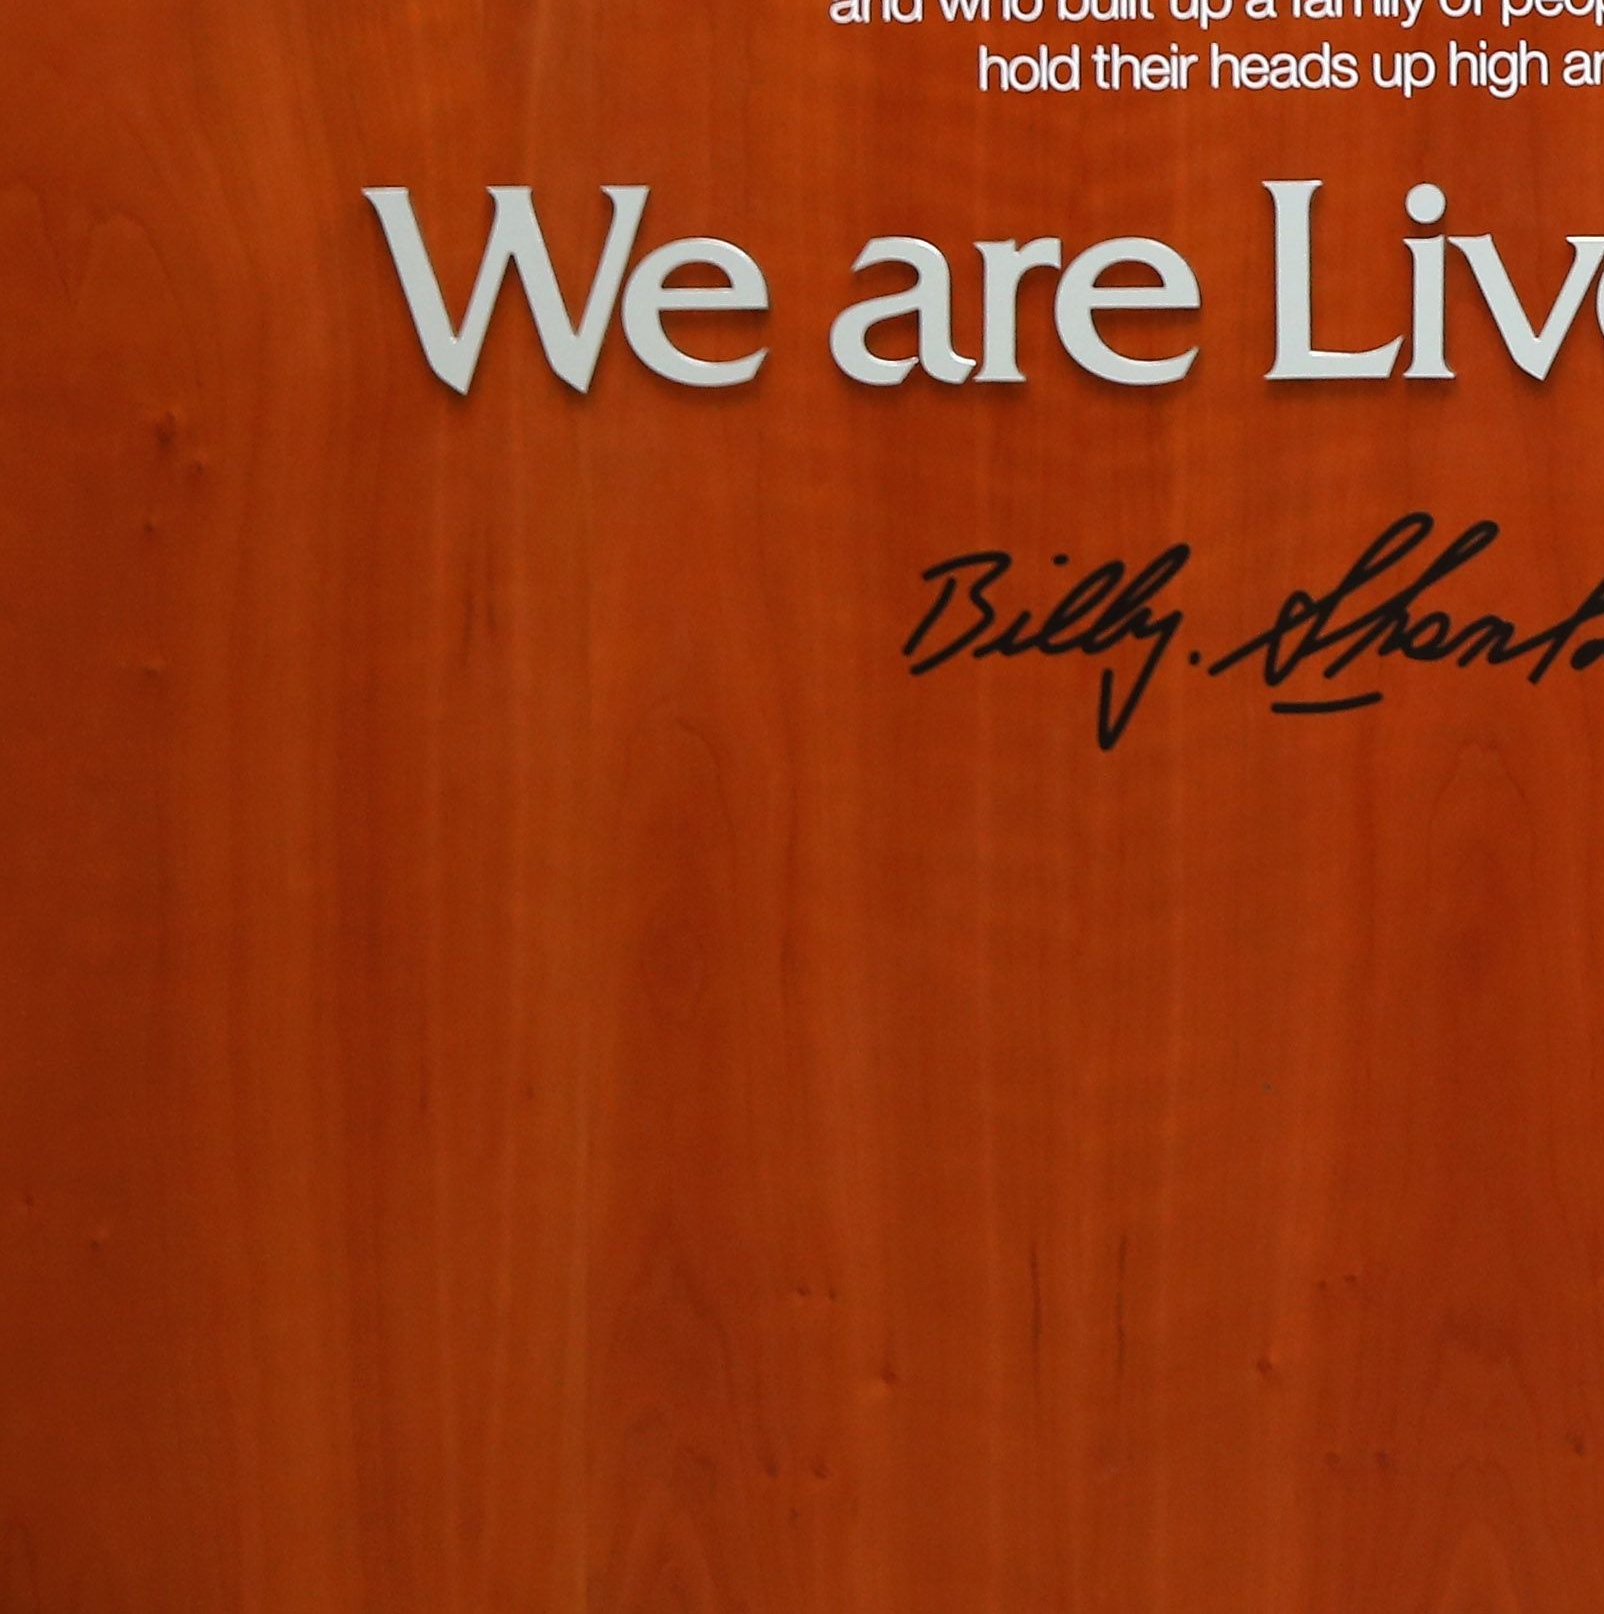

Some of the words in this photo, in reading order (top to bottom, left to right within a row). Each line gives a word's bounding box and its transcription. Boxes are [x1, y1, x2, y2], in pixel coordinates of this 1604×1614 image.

[980, 45, 1080, 92] hold
[1093, 44, 1199, 91] their
[1212, 43, 1359, 90] heads
[1374, 53, 1436, 99] up
[1451, 41, 1549, 99] high
[364, 187, 769, 394] We
[831, 238, 1201, 386] are
